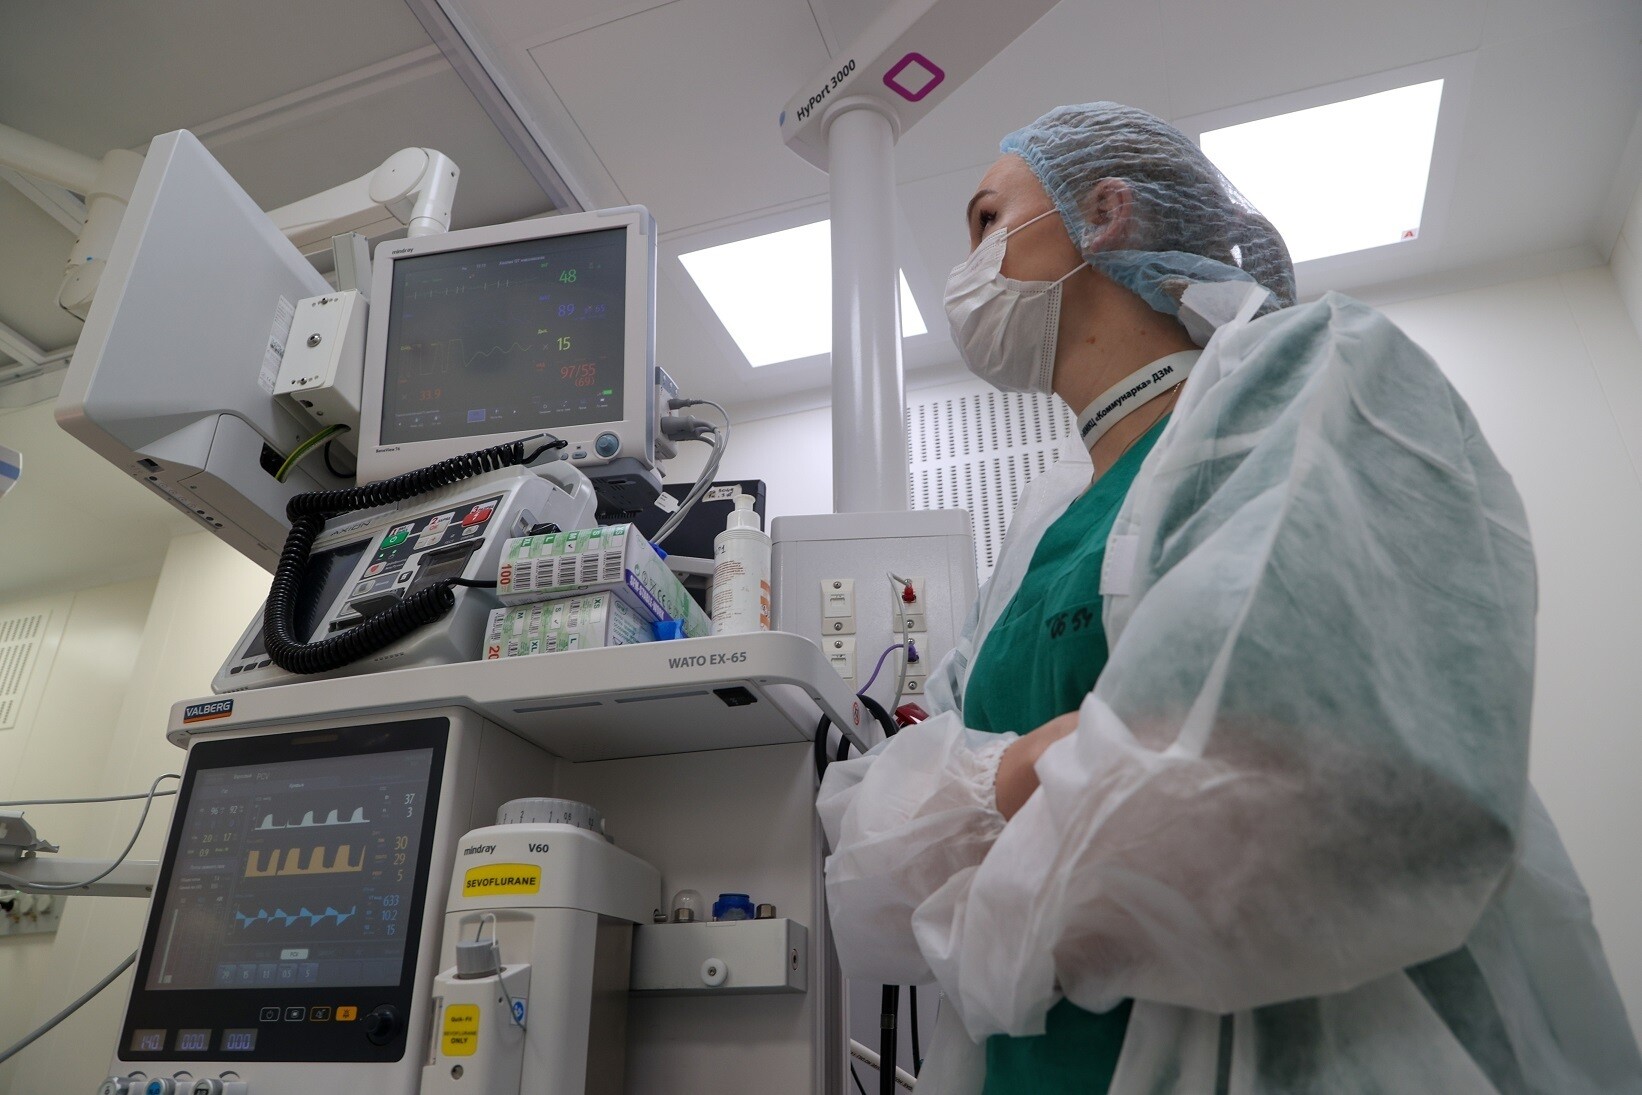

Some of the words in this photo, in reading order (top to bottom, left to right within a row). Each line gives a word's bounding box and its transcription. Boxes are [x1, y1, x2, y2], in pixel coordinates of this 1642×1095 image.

[796, 84, 830, 121] HyPort
[830, 59, 856, 89] 3000
[559, 269, 577, 284] 48
[558, 303, 575, 317] 89
[557, 336, 571, 351] 15
[560, 363, 596, 379] 97/55
[574, 377, 595, 388] (69)
[1095, 379, 1151, 422] «Коммунарка»
[1152, 365, 1174, 384] ДЗМ
[500, 563, 512, 585] 100
[594, 598, 601, 609] XS
[531, 641, 538, 652] XL
[668, 655, 706, 669] WATO
[710, 652, 747, 666] EX-65
[186, 701, 231, 717] VALBERG
[404, 793, 415, 805] 37
[406, 807, 413, 818] 3
[394, 835, 408, 850] 30
[463, 844, 496, 856] mindray
[528, 843, 549, 854] V60
[393, 853, 406, 866] 29
[397, 869, 403, 882] 5
[466, 876, 537, 889] SEVOFLURANE
[383, 894, 400, 907] 633
[387, 924, 395, 936] 15
